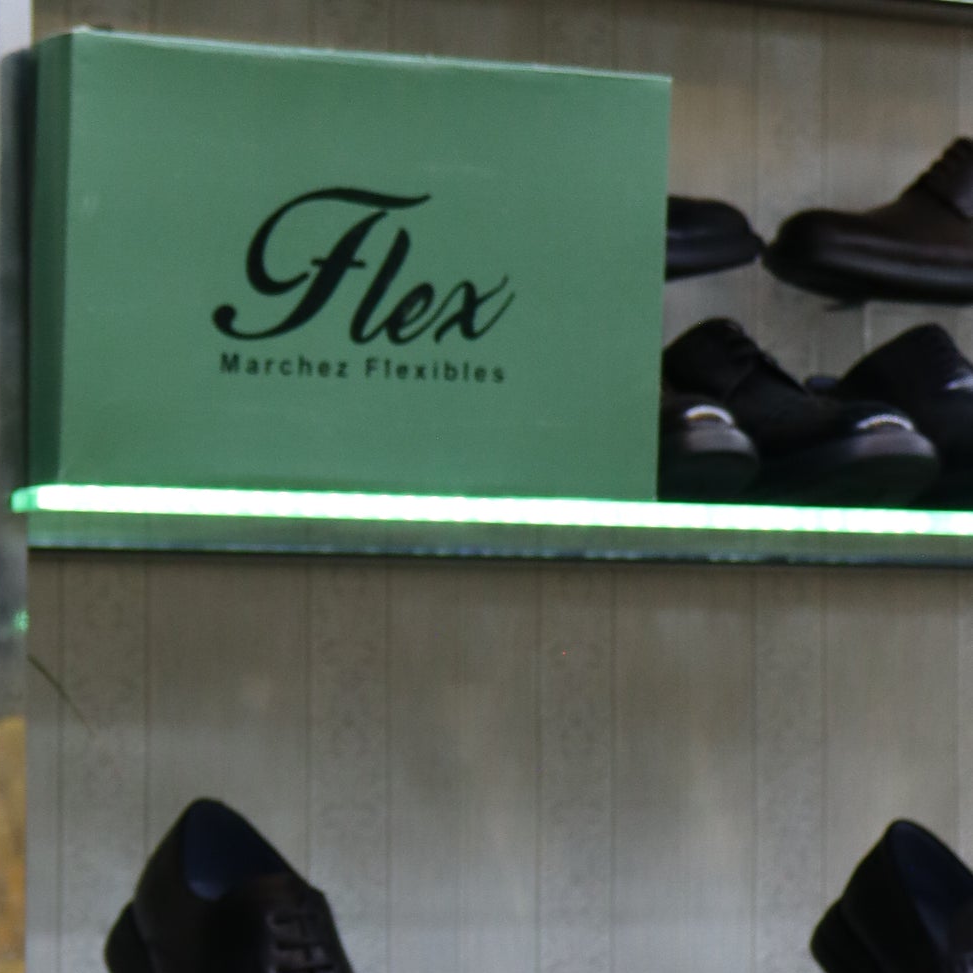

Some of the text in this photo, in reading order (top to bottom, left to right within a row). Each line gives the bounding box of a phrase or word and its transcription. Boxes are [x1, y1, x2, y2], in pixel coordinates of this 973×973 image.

[212, 187, 515, 345] Flex
[220, 353, 506, 383] Marchez Flexibles
